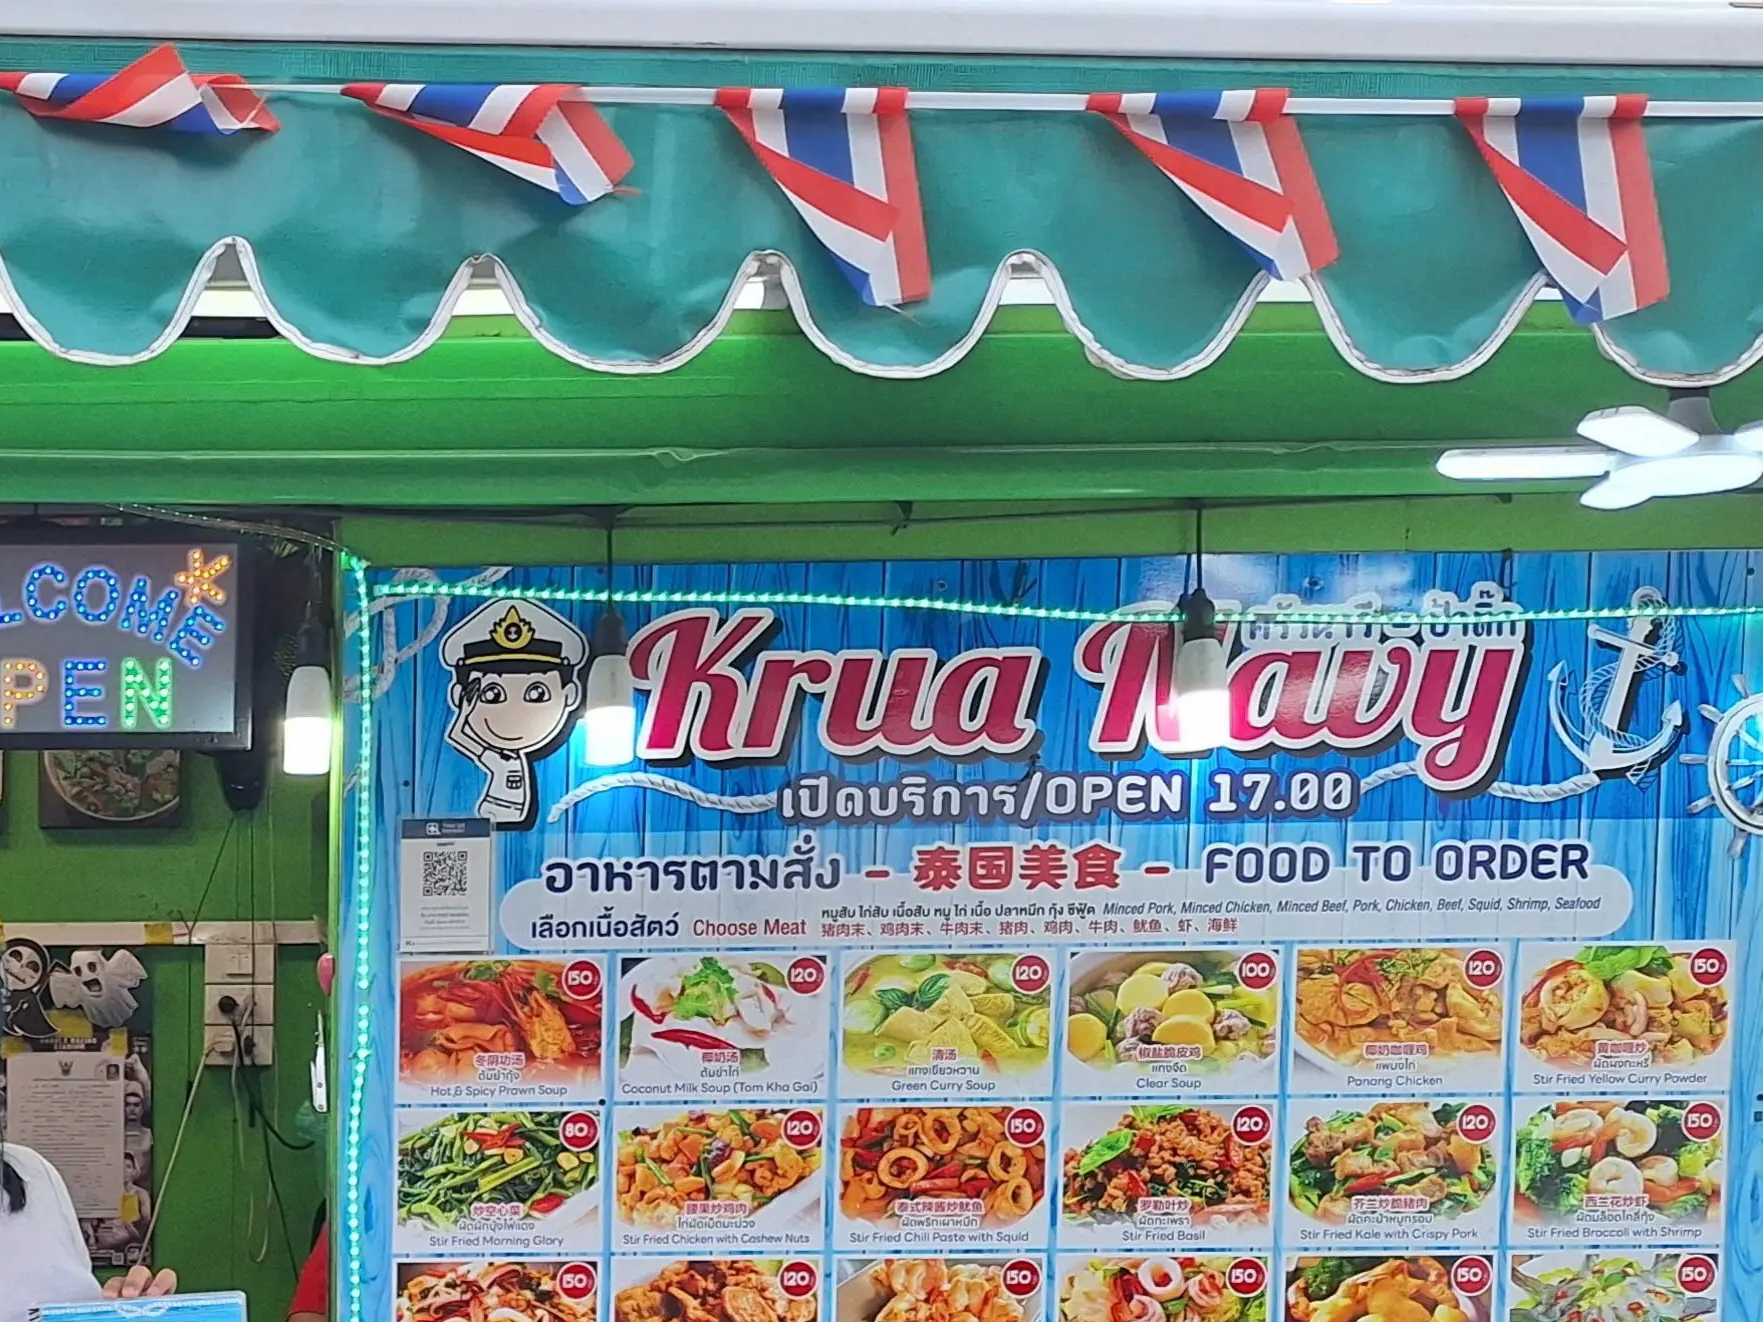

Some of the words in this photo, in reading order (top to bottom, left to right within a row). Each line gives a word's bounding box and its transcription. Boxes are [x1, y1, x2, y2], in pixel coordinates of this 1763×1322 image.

[627, 608, 1041, 760] Krua
[1075, 602, 1525, 790] Navy
[782, 772, 1182, 820] เปิดบริการ/OPEN
[1208, 774, 1353, 811] 17.00
[545, 834, 840, 893] อาหารตามสั่ง
[913, 843, 1120, 893] 泰国美食
[1205, 847, 1330, 884] FOOD
[1353, 846, 1412, 882] TO
[1436, 844, 1589, 882] ORDER
[859, 904, 889, 918] ไก่สับ
[1103, 903, 1144, 914] Minced
[1148, 903, 1176, 915] Pork,
[1181, 901, 1222, 913] Minced
[1226, 901, 1273, 914] Chicken,
[1277, 901, 1318, 912] Minced
[1322, 900, 1348, 913] Beef,
[1353, 900, 1381, 912] Pork,
[1386, 899, 1433, 912] Chicken,
[1437, 899, 1464, 911] Beef,
[1468, 899, 1502, 912] Squid,
[1507, 898, 1551, 912] Shrimp,
[1555, 897, 1601, 909] Seafood
[530, 905, 678, 940] เลือกเนื้อสัตว์
[693, 917, 758, 937] Choose
[764, 917, 807, 936] Meat
[622, 1082, 672, 1094] Coconut
[675, 1082, 698, 1094] Milk
[702, 1083, 729, 1096] Soup
[733, 1082, 764, 1094] (Tom
[767, 1082, 788, 1094] Kha
[792, 1082, 818, 1094] Gai)
[892, 1080, 927, 1091] Green
[930, 1080, 963, 1093] Curry
[966, 1080, 995, 1093] Soup
[1136, 1078, 1168, 1089] Clear
[1172, 1078, 1201, 1091] Soup
[1348, 1075, 1392, 1088] Panang
[1396, 1075, 1443, 1085] Chicken
[1123, 1230, 1142, 1241] Stir
[1145, 1230, 1174, 1241] Fried
[1178, 1230, 1205, 1241] Basil
